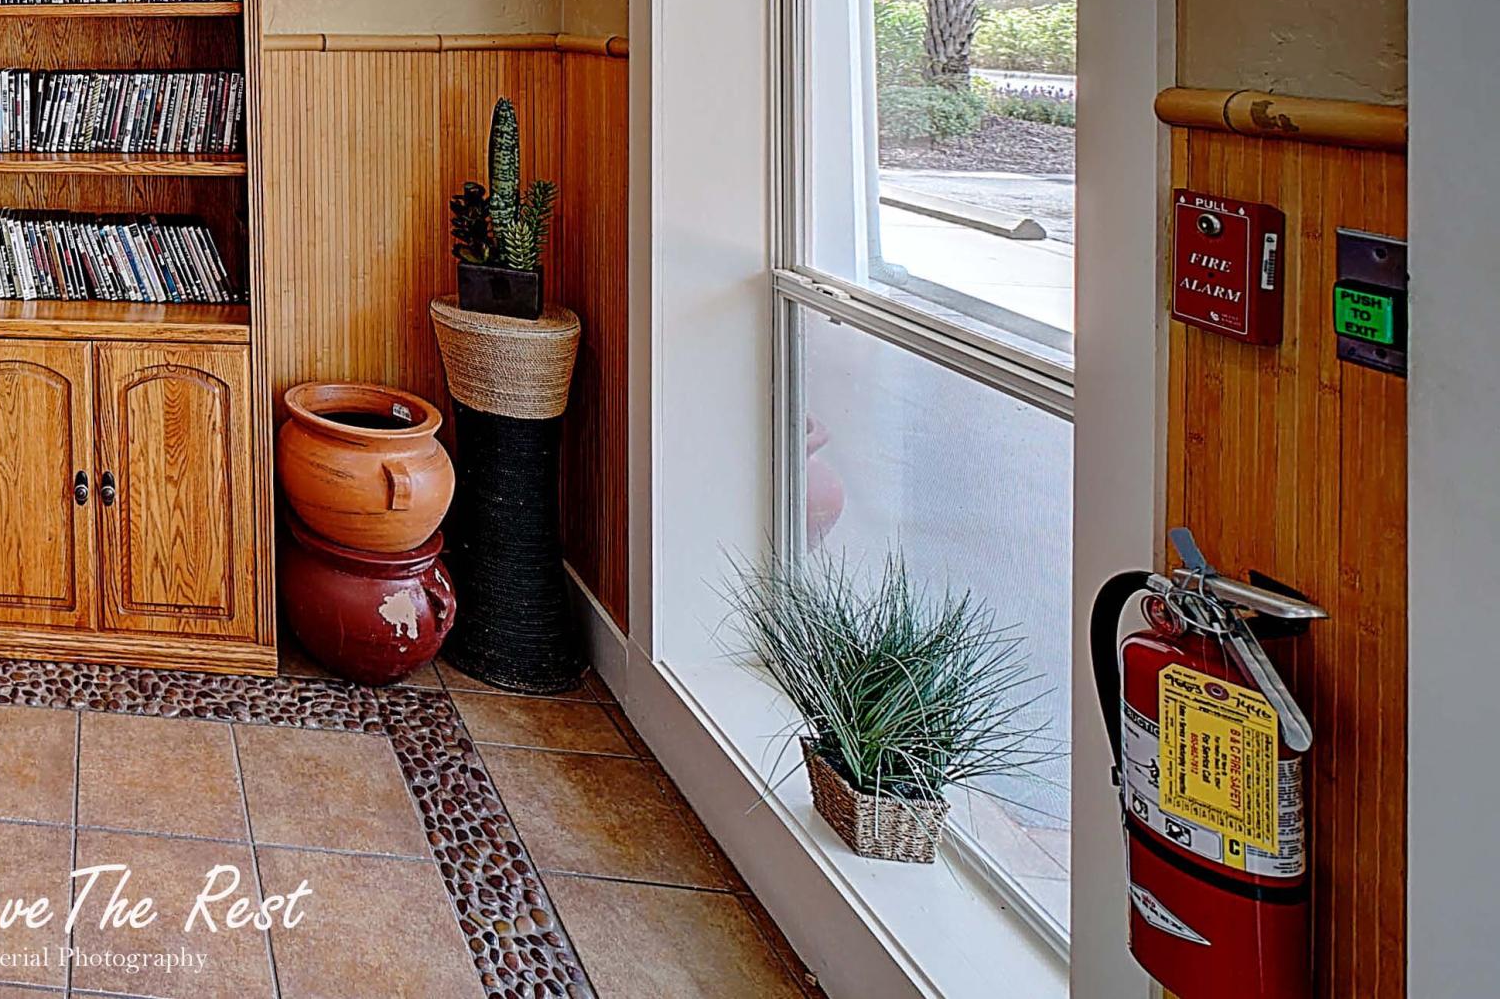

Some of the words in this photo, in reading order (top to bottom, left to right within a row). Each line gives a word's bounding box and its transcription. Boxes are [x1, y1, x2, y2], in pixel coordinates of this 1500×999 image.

[1195, 197, 1228, 212] PULL
[1189, 252, 1233, 273] FIRE
[1180, 277, 1242, 303] ALARM
[1340, 290, 1382, 309] PUSH
[1350, 308, 1371, 322] TO
[1345, 322, 1379, 339] EXIT
[1202, 744, 1211, 769] Service
[1230, 753, 1241, 776] FIRE
[1230, 776, 1241, 811] SAFETY
